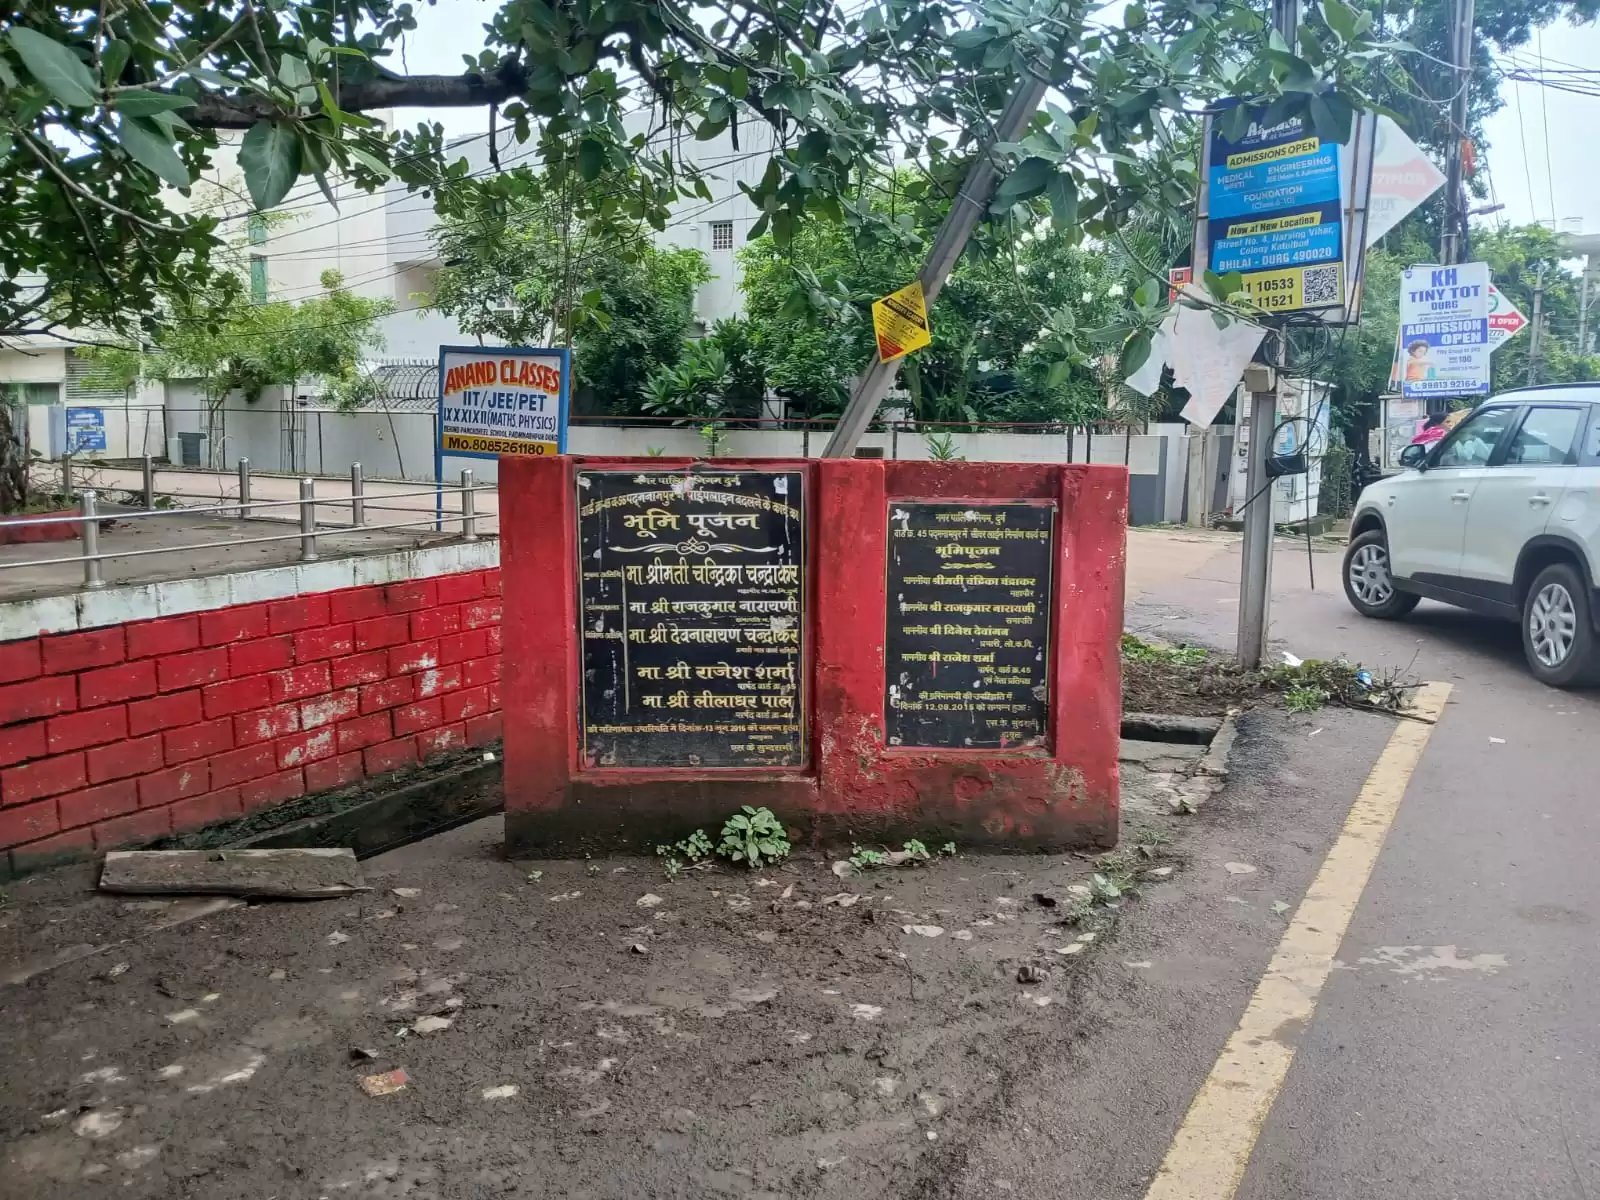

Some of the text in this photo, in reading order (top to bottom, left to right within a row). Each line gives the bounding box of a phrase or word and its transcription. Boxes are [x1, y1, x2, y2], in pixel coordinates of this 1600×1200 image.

[1230, 141, 1316, 166] ADMISSIONS OPEN
[1268, 155, 1332, 175] ENGINEERING
[1217, 170, 1254, 185] MEDICAL
[1243, 185, 1302, 202] FOUNDATION
[1230, 216, 1314, 236] Now at New Location
[1218, 239, 1242, 250] Street
[1240, 245, 1268, 256] Colony
[1219, 259, 1251, 270] BHILAI
[1262, 253, 1289, 265] DURG
[1292, 247, 1332, 261] 490020
[1257, 278, 1294, 292] 10533
[1432, 268, 1457, 288] KH
[1257, 294, 1293, 308] 11521
[1409, 285, 1481, 303] TINY TOT
[1432, 300, 1458, 310] DURG
[1407, 320, 1481, 336] ADMISSION
[1441, 332, 1482, 345] OPEN
[444, 360, 560, 396] ANAND CLASSES
[1450, 380, 1477, 388] 92164
[463, 391, 547, 412] IIT/JEE/PET
[490, 429, 507, 438] SCHOOL
[623, 508, 760, 539] भूमि पूजन
[917, 529, 928, 538] 45
[935, 543, 1001, 559] भूमिपूजन
[646, 556, 690, 585] श्रीमती
[692, 556, 743, 587] चन्द्रिका
[932, 574, 964, 585] श्रीमती
[966, 574, 999, 585] चंद्रिका
[650, 597, 669, 613] श्री
[671, 601, 736, 618] राजकुमार
[739, 597, 798, 612] नारायणी
[929, 601, 942, 612] श्री
[943, 603, 992, 615] राजकुमार
[992, 602, 1036, 613] नारायणी
[648, 622, 667, 644] श्री
[670, 624, 741, 644] देवनारायण
[929, 624, 942, 635] श्री
[944, 624, 972, 635] दिनेश
[974, 624, 1010, 636] देवांगन
[928, 651, 941, 662] श्री
[942, 651, 971, 662] राजेश
[972, 652, 996, 663] शर्मा
[666, 661, 691, 680] श्री
[696, 662, 748, 680] राजेश
[755, 661, 795, 680] शर्मा
[667, 690, 690, 708] श्री
[693, 690, 758, 708] लीलाधर
[760, 695, 794, 708] पाल
